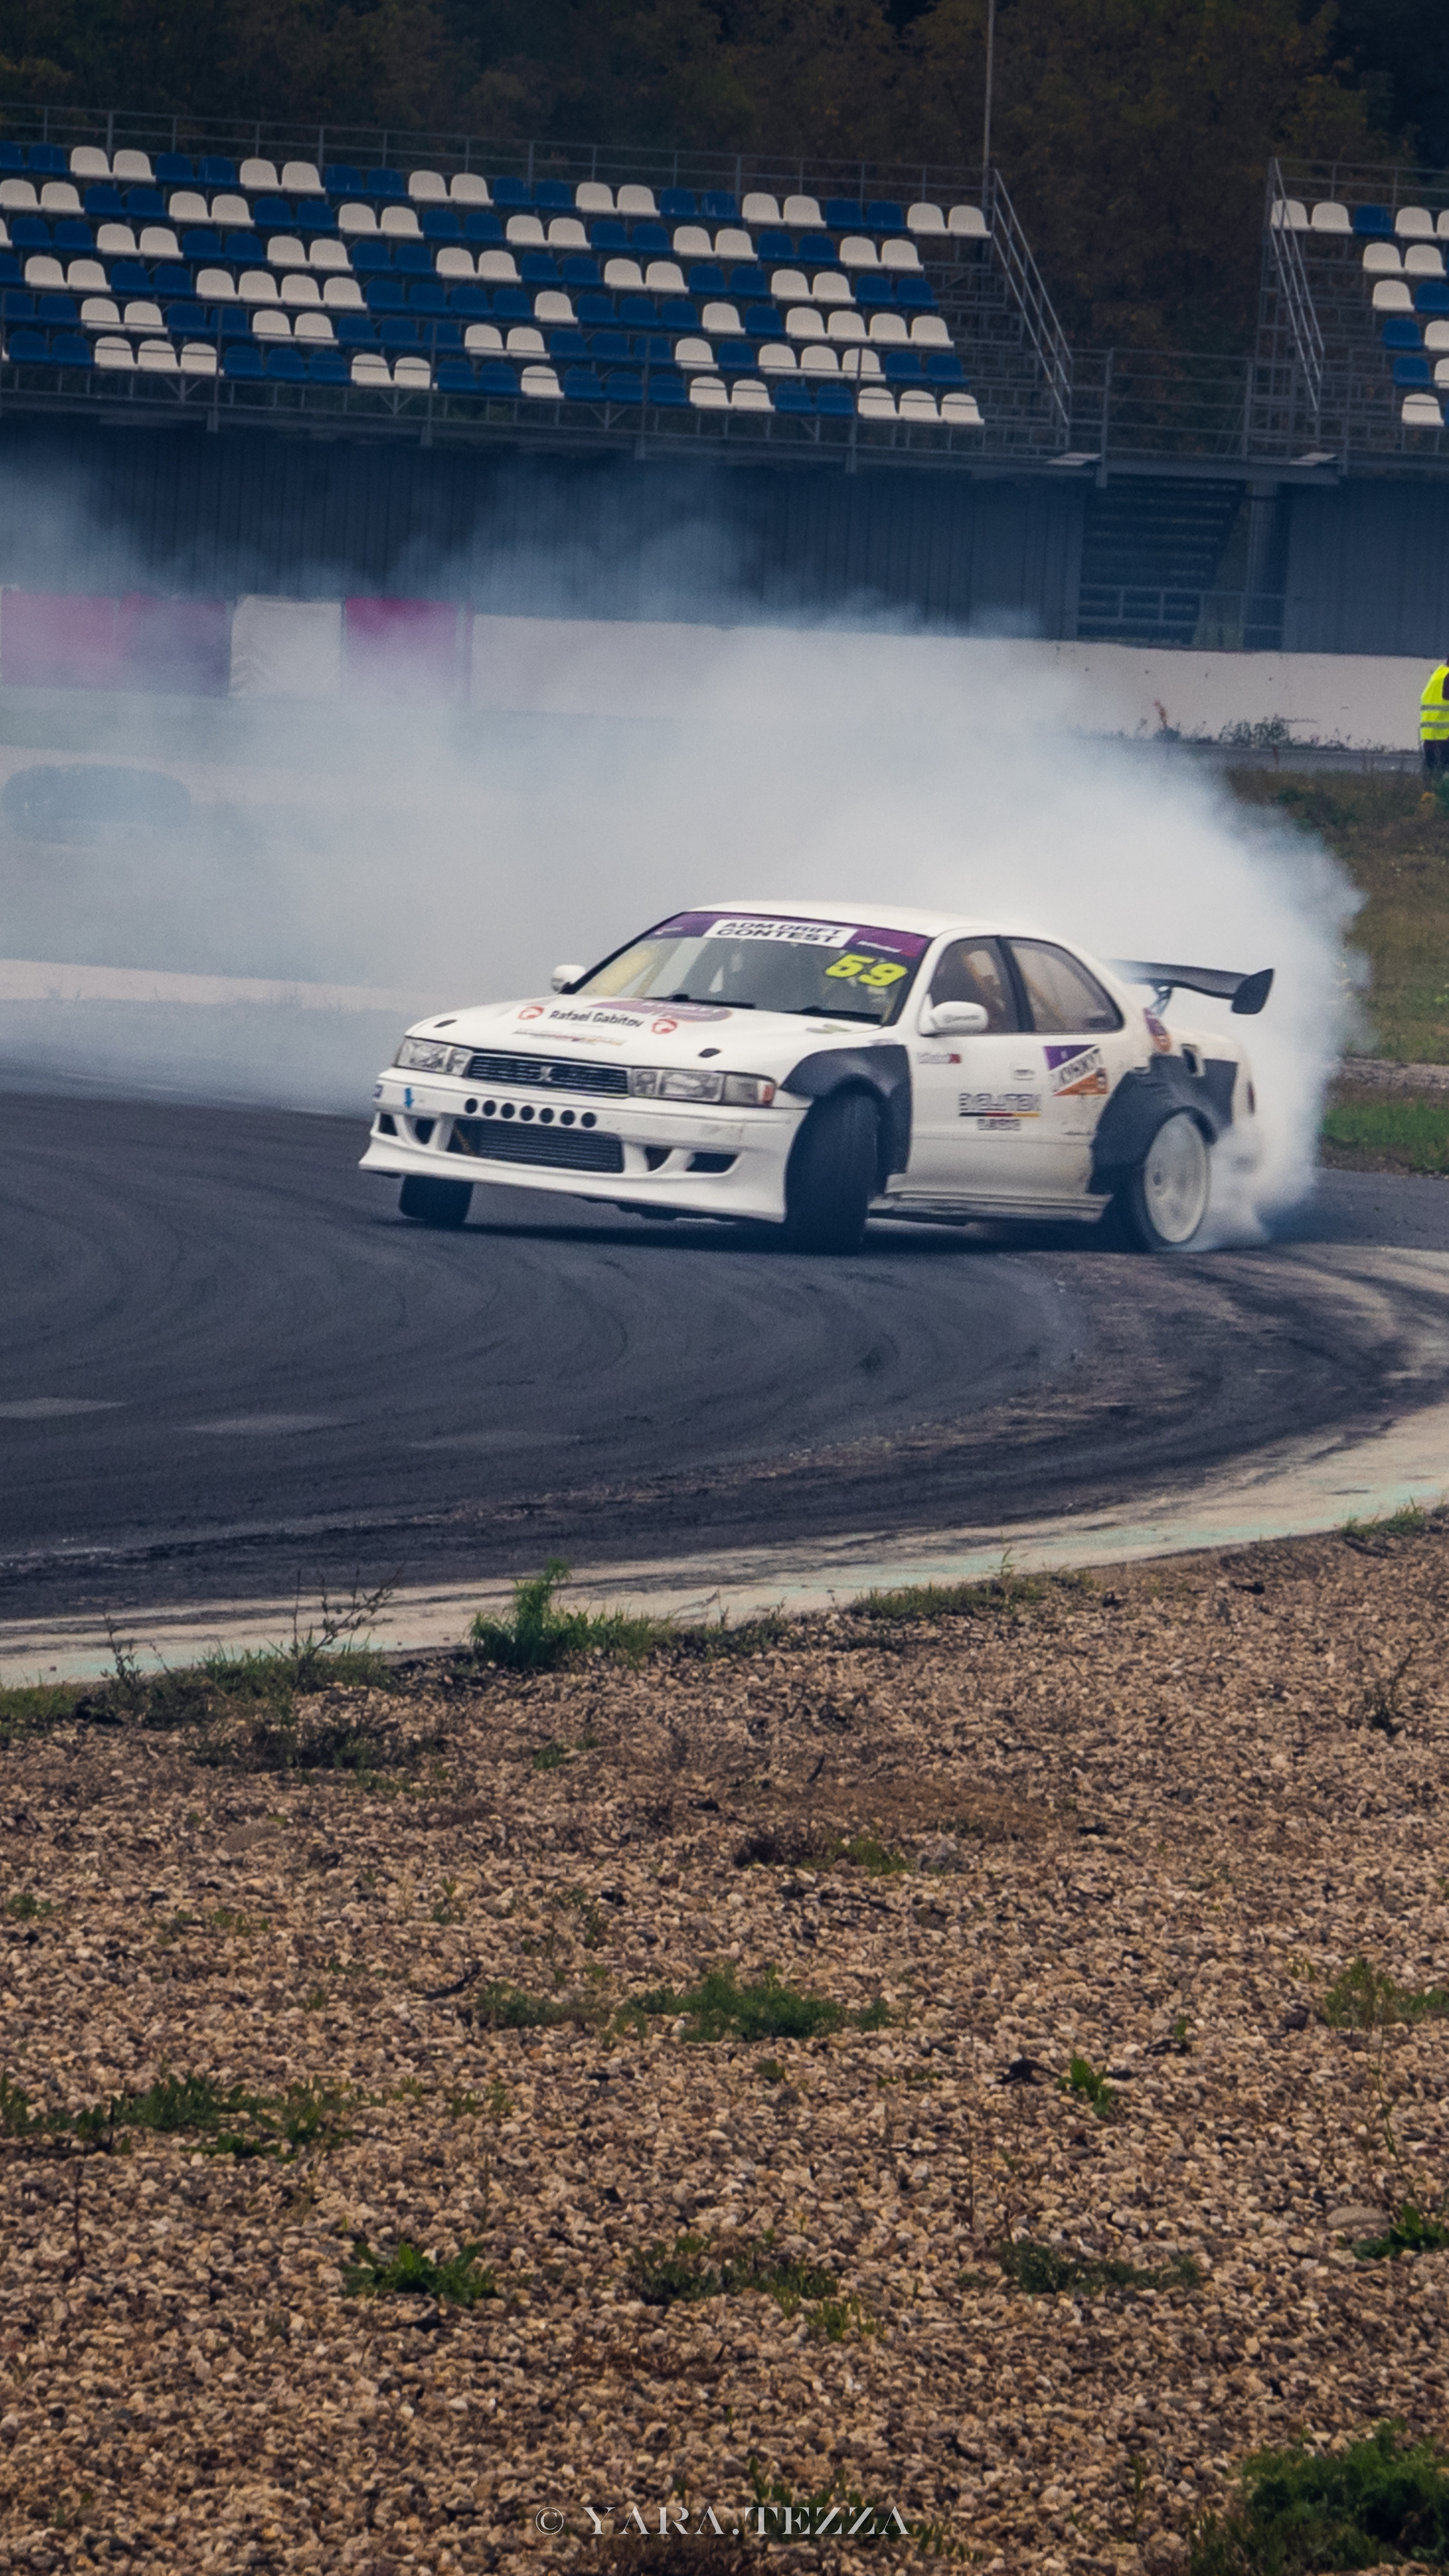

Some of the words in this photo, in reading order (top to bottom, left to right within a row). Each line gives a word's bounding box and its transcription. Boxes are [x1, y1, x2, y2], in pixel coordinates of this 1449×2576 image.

[717, 929, 840, 943] CONTEST
[778, 924, 845, 935] DRIFT
[824, 953, 908, 987] 59
[549, 1010, 592, 1022] Rafael
[592, 1012, 645, 1028] Gabitov
